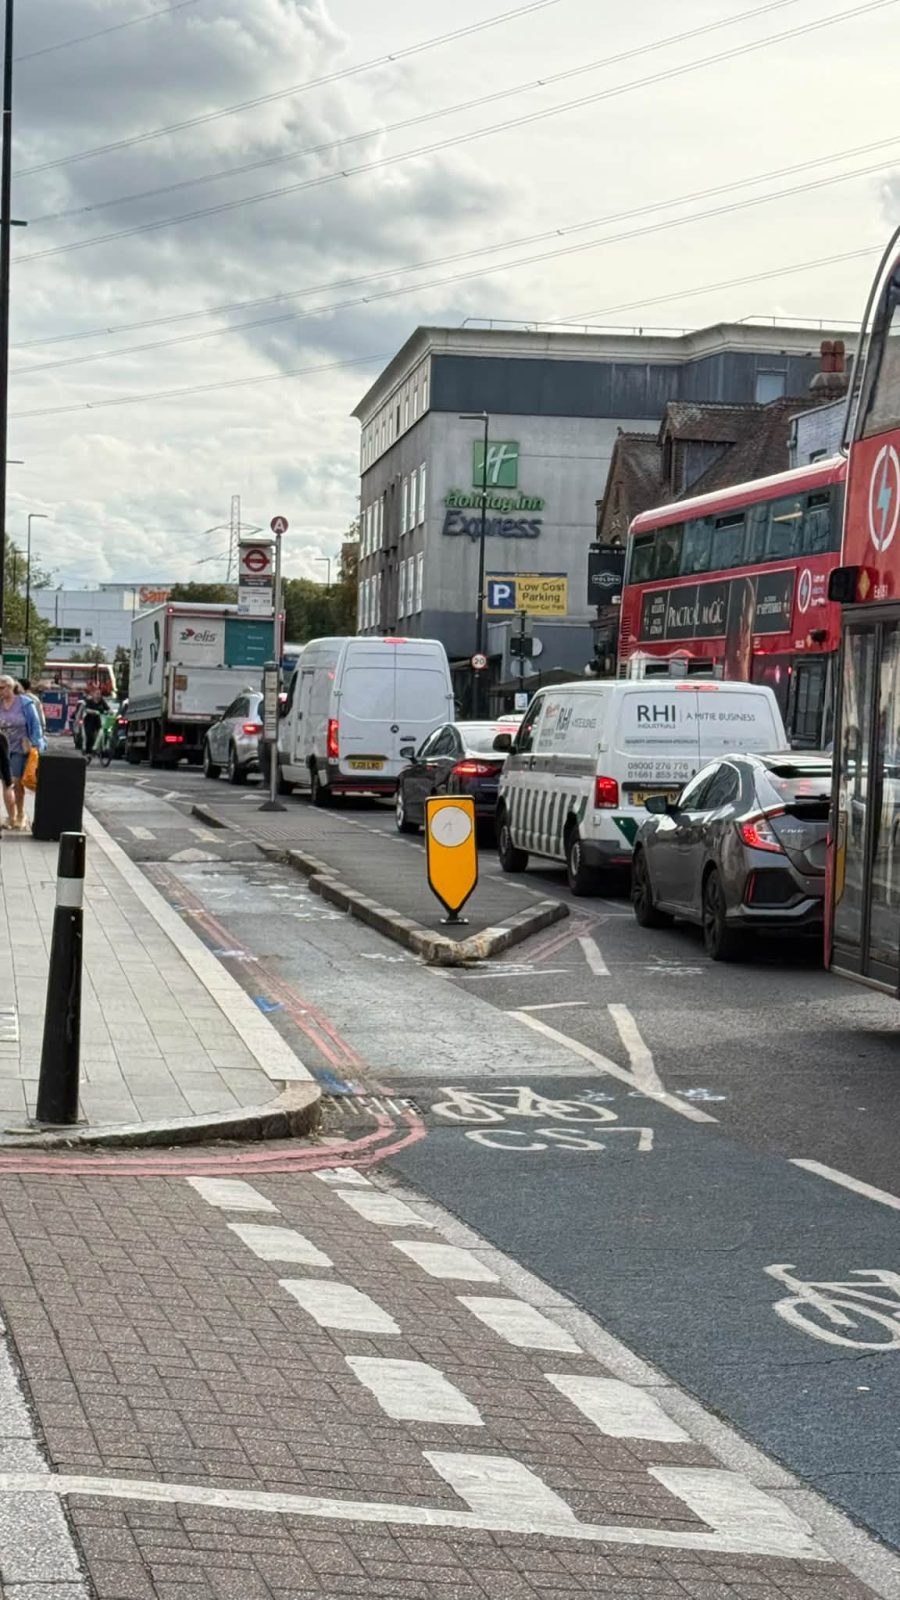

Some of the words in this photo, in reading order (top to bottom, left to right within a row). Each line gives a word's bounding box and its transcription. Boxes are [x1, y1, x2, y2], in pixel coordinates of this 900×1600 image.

[444, 488, 513, 514] Holiday
[516, 491, 545, 511] Inn
[274, 519, 285, 531] A
[442, 510, 542, 542] Express
[492, 584, 511, 606] P
[518, 583, 539, 591] Low
[542, 583, 565, 591] Cost
[522, 593, 560, 603] Parking
[193, 630, 217, 642] elis
[637, 704, 676, 722] RHI
[718, 713, 756, 722] BUSINESS
[464, 1127, 654, 1151] CS7
